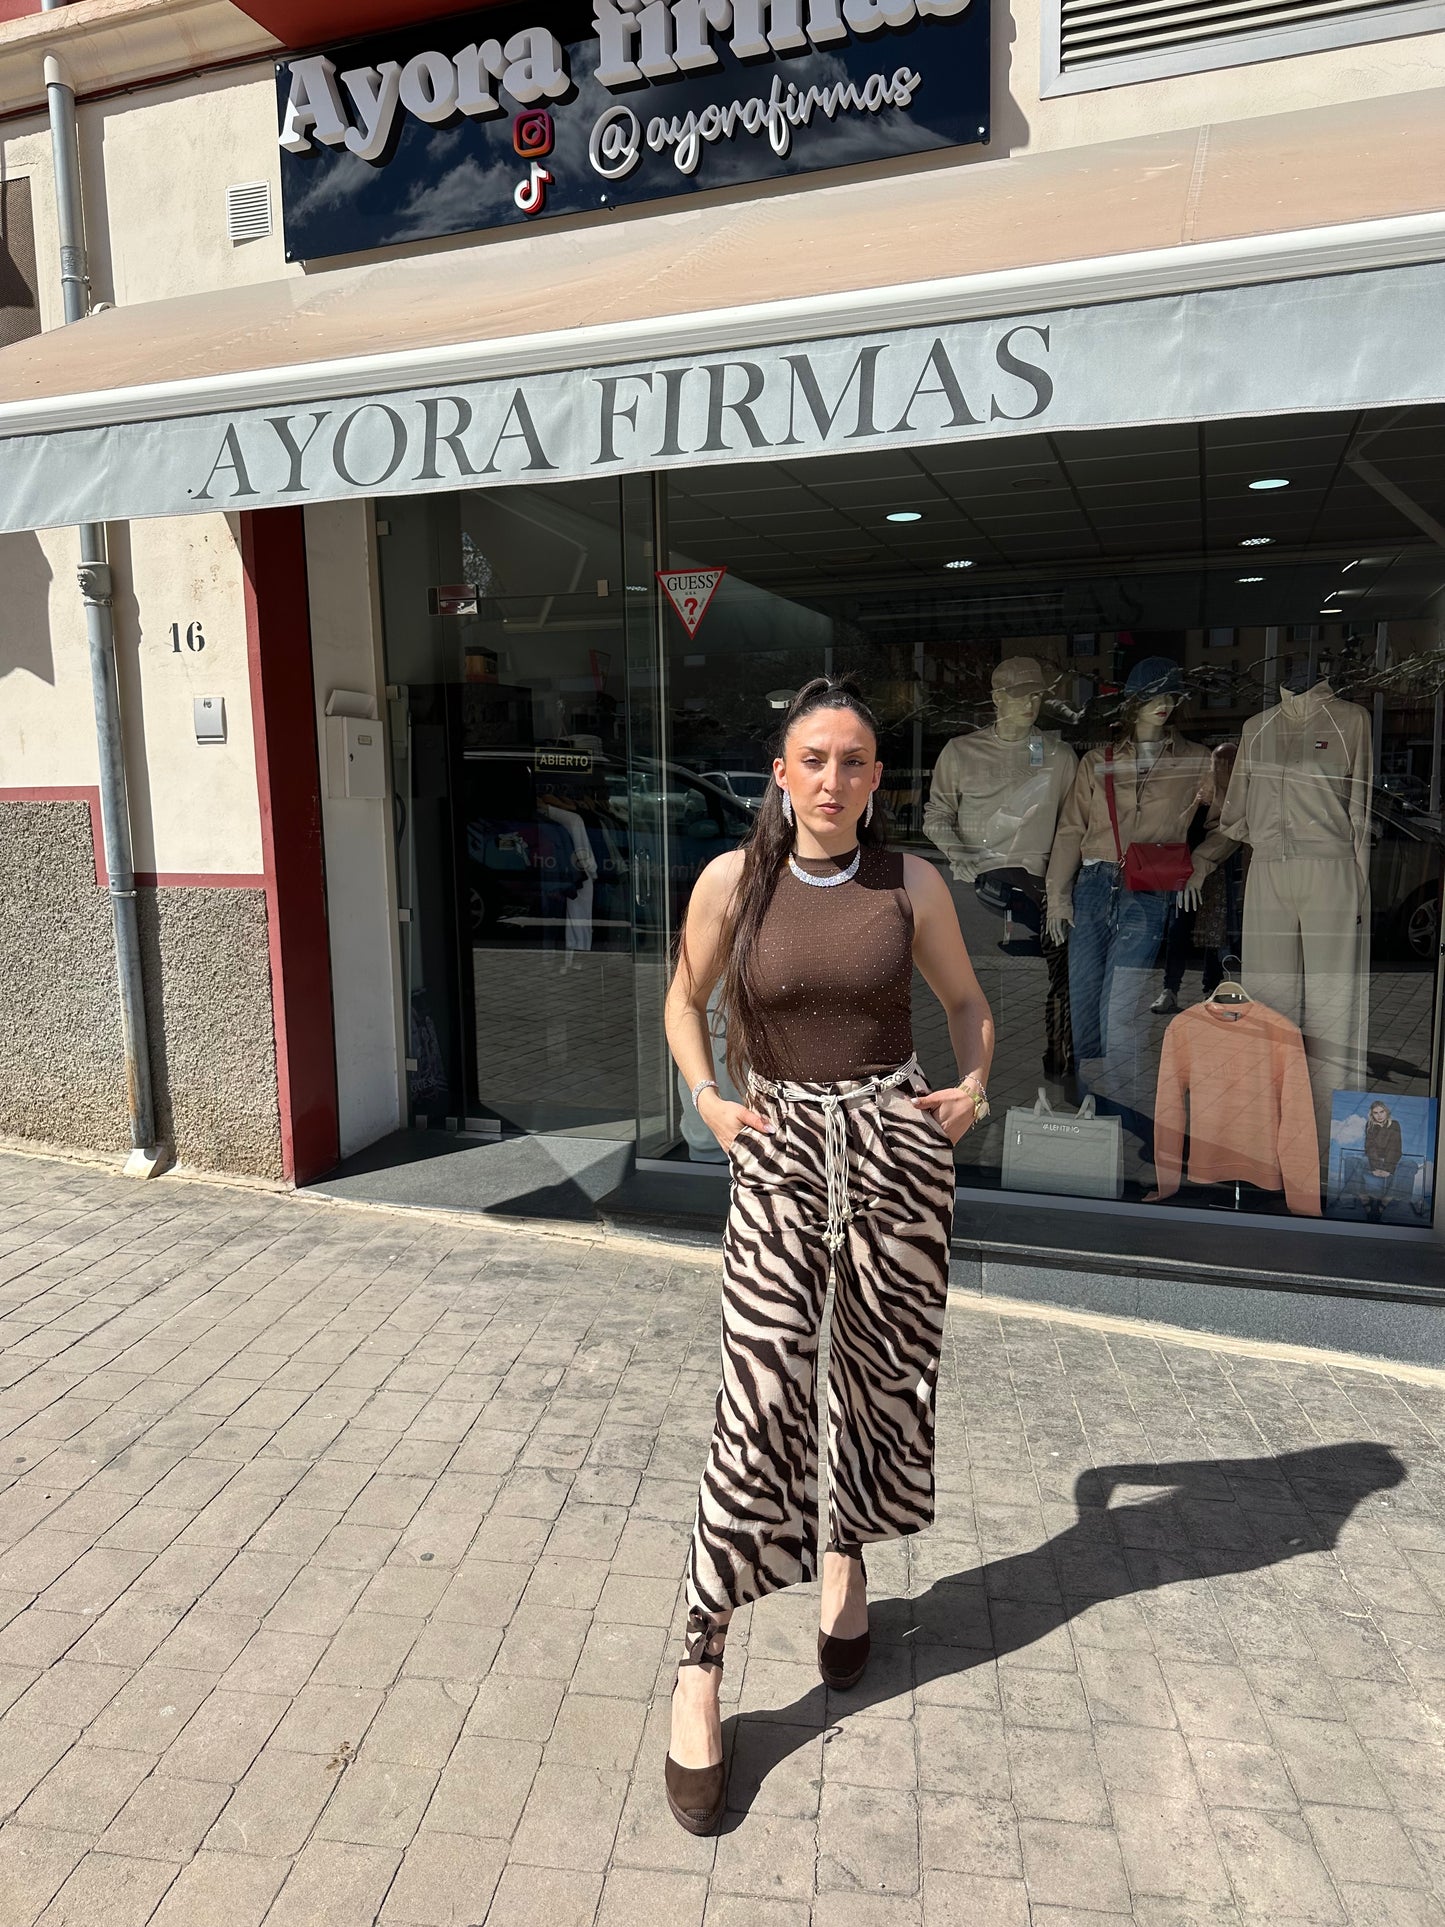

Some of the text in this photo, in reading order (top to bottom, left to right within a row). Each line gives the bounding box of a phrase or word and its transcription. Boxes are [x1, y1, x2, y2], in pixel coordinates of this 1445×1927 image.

[278, 0, 972, 161] Ayora firm
[588, 65, 922, 180] @ayorafirmas
[190, 324, 1054, 500] AYORA FIRMAS
[667, 574, 714, 592] GUESS
[168, 620, 206, 654] 16
[539, 753, 589, 768] ABIERTO
